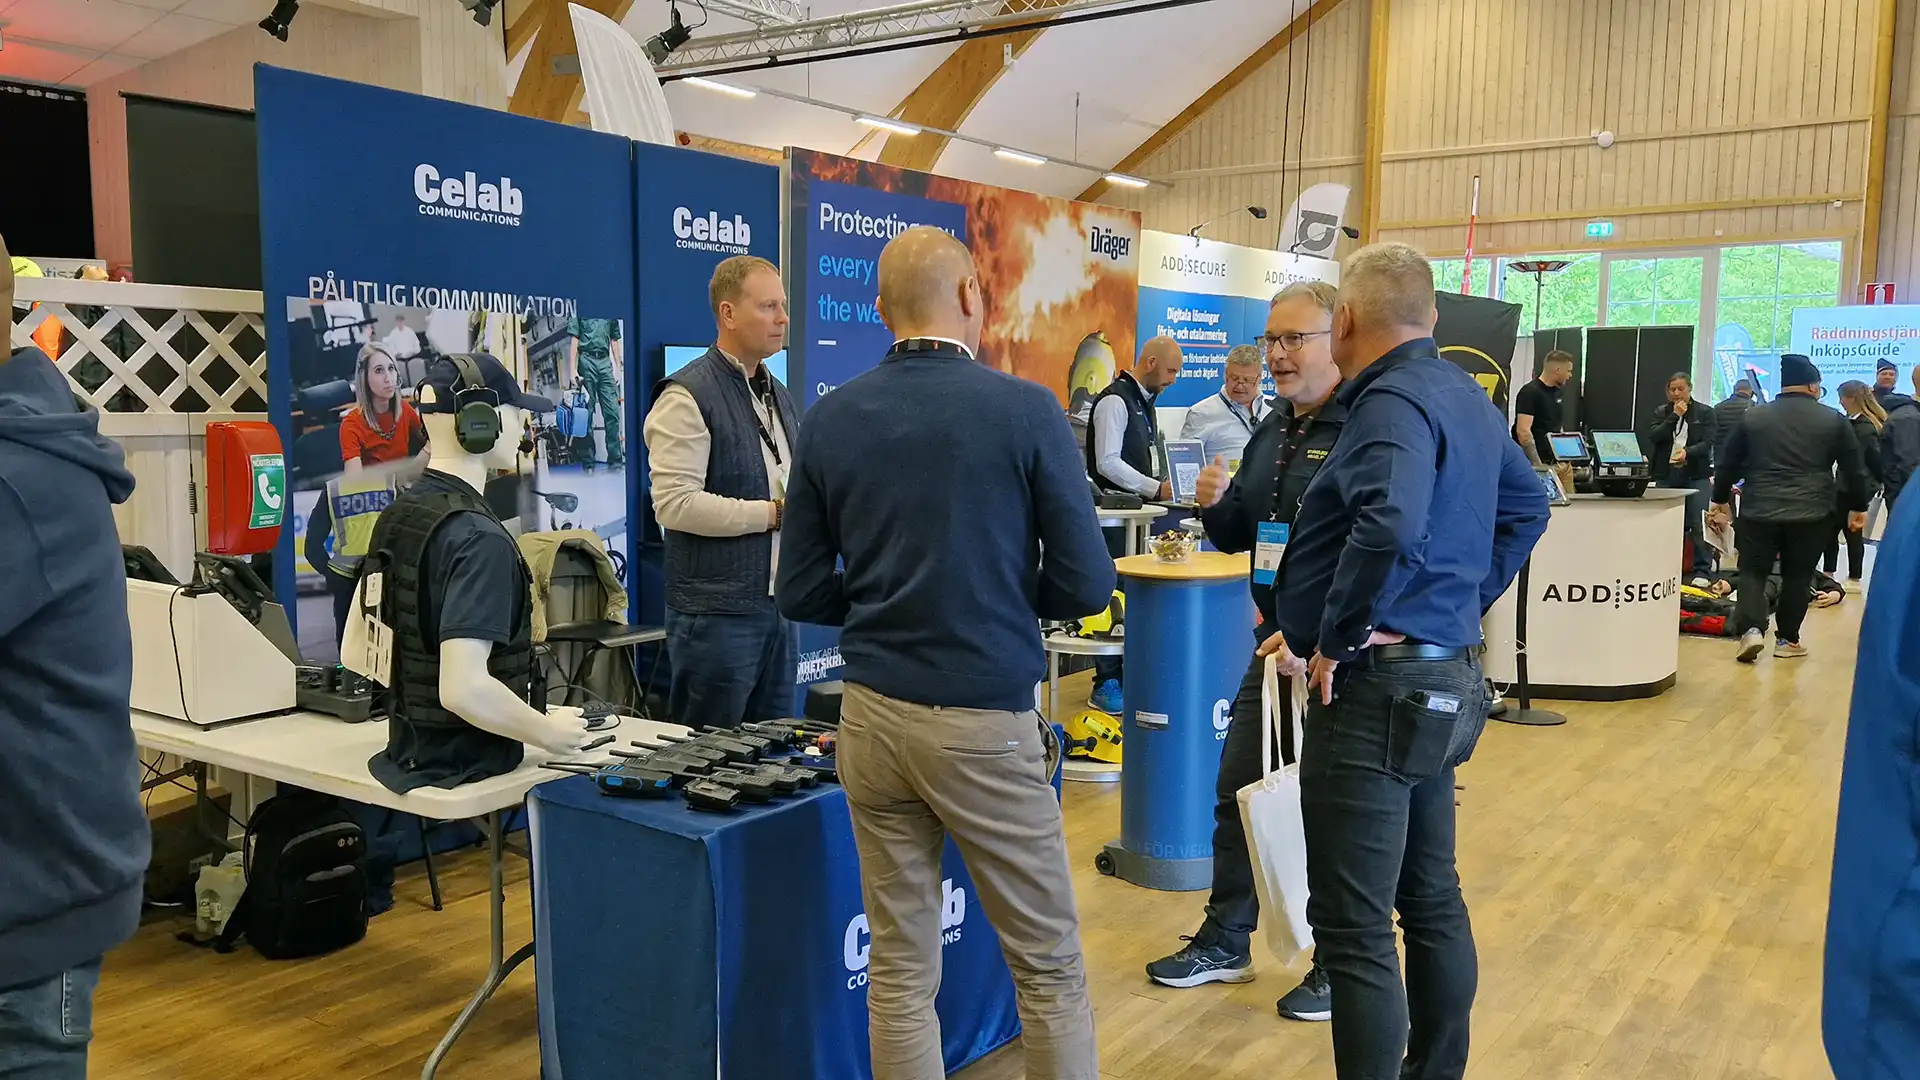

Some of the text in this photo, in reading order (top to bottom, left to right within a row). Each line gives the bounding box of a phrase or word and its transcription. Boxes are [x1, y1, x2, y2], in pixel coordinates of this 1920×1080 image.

[414, 163, 523, 216] Celab
[418, 204, 520, 227] COMMUNICATIONS
[673, 206, 751, 246] Celab
[820, 202, 919, 240] Protectin
[675, 239, 749, 255] COMMUNICATIONS
[1091, 226, 1131, 260] Dräger
[818, 254, 874, 285] every
[308, 270, 577, 318] PÅLITLIG KOMMUNIKATION
[818, 294, 889, 329] the wa
[1166, 306, 1220, 326] Digitala lösningar
[1177, 326, 1189, 340] och
[1812, 325, 1920, 341] Räddningstjän
[339, 492, 389, 517] POLIS
